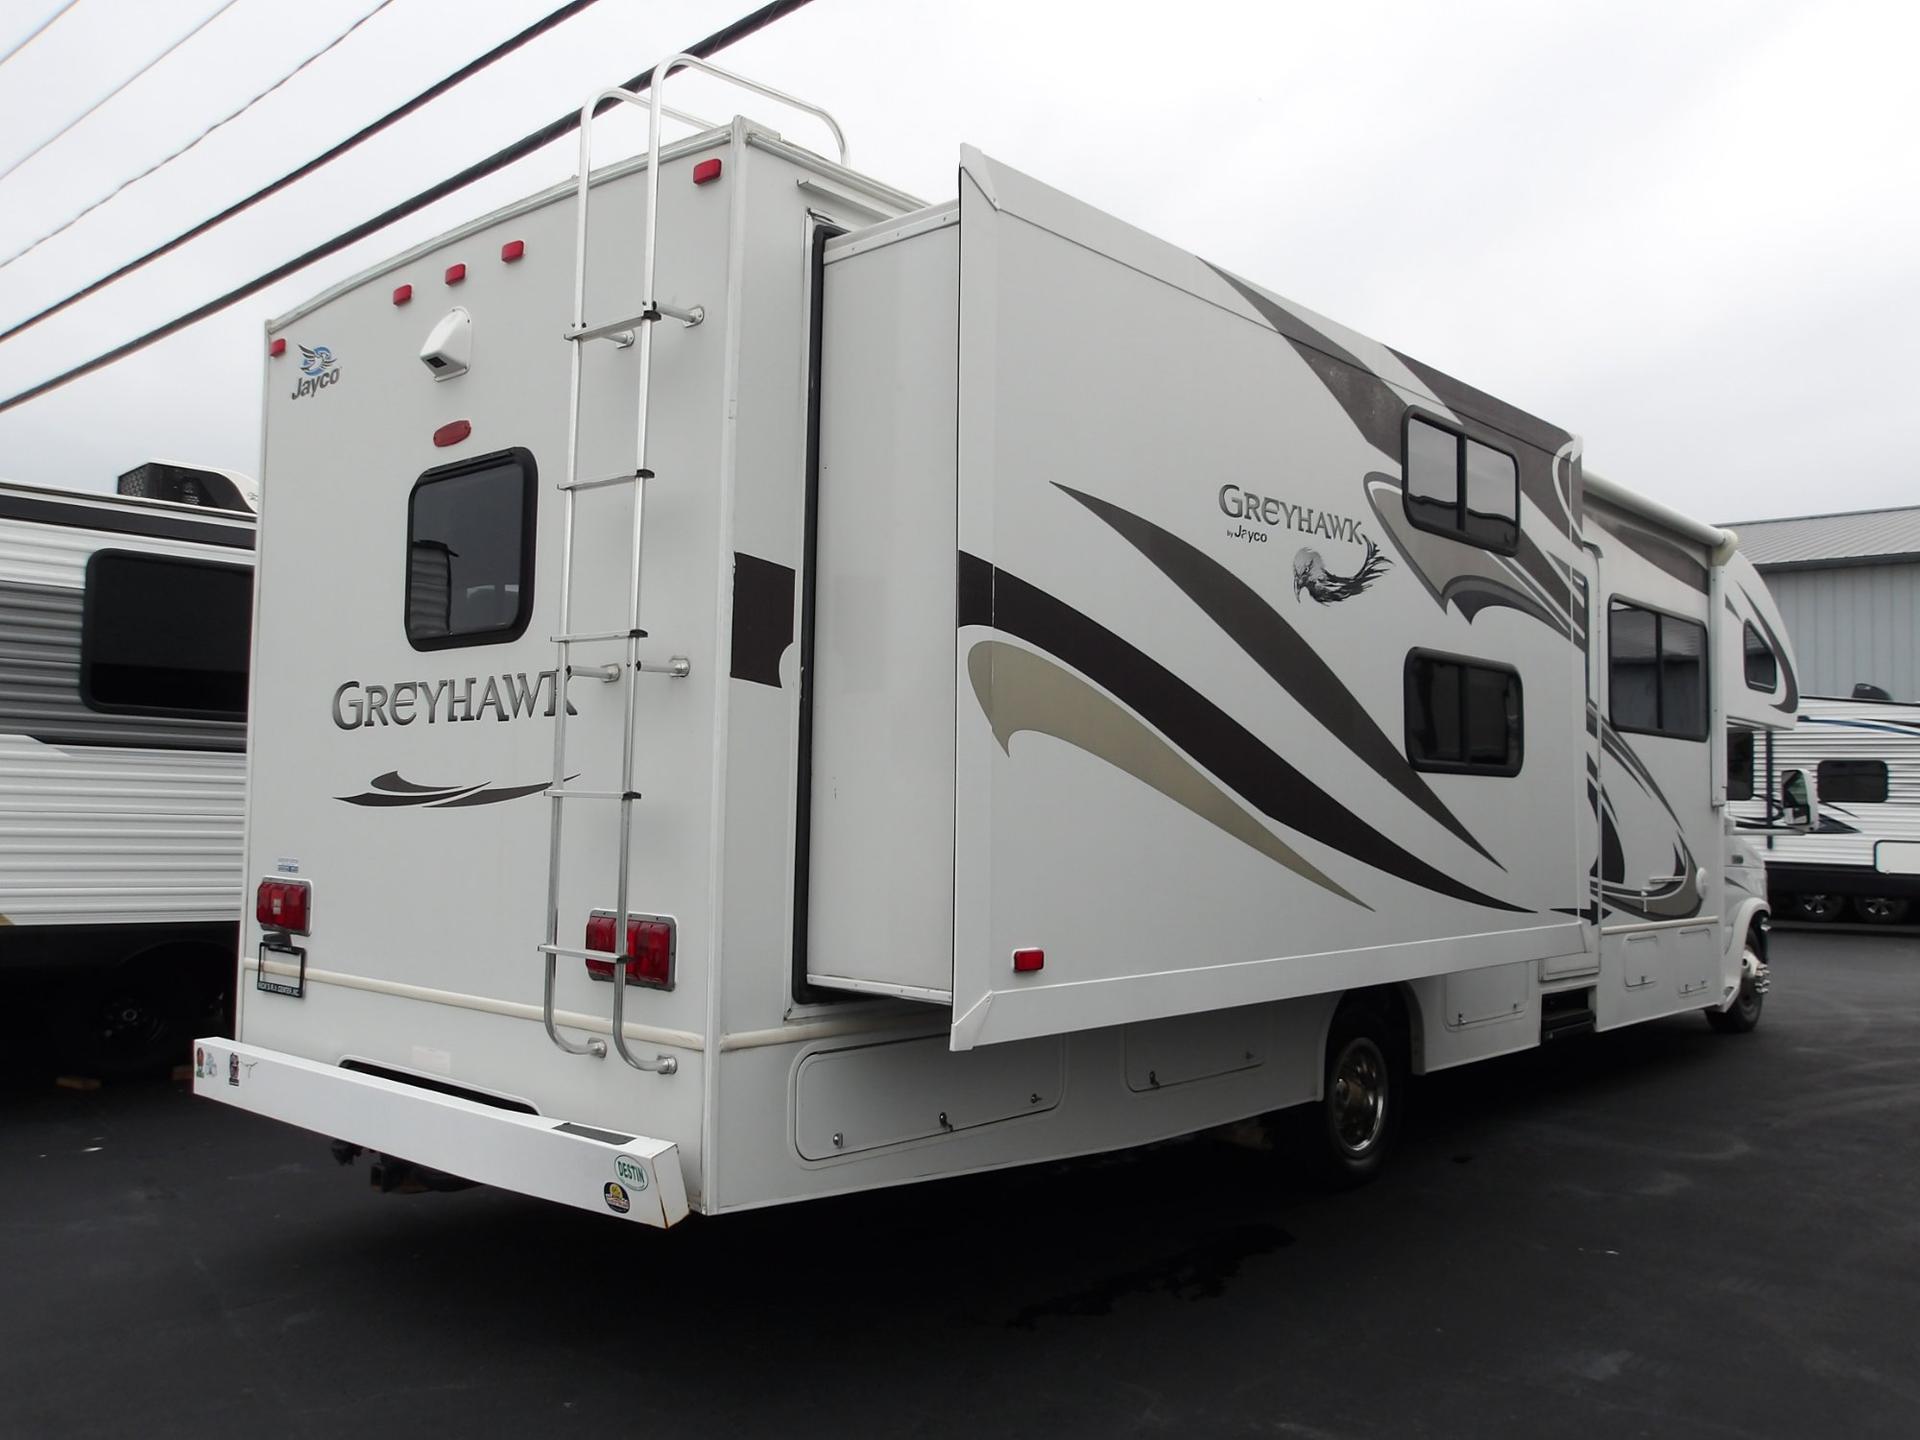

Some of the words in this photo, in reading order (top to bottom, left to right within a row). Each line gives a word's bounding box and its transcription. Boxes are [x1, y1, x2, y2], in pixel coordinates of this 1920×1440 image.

[291, 367, 340, 400] Jayco
[1218, 484, 1363, 545] GREYHAWK
[1234, 525, 1268, 543] Jayco
[617, 1160, 645, 1183] DESTIN
